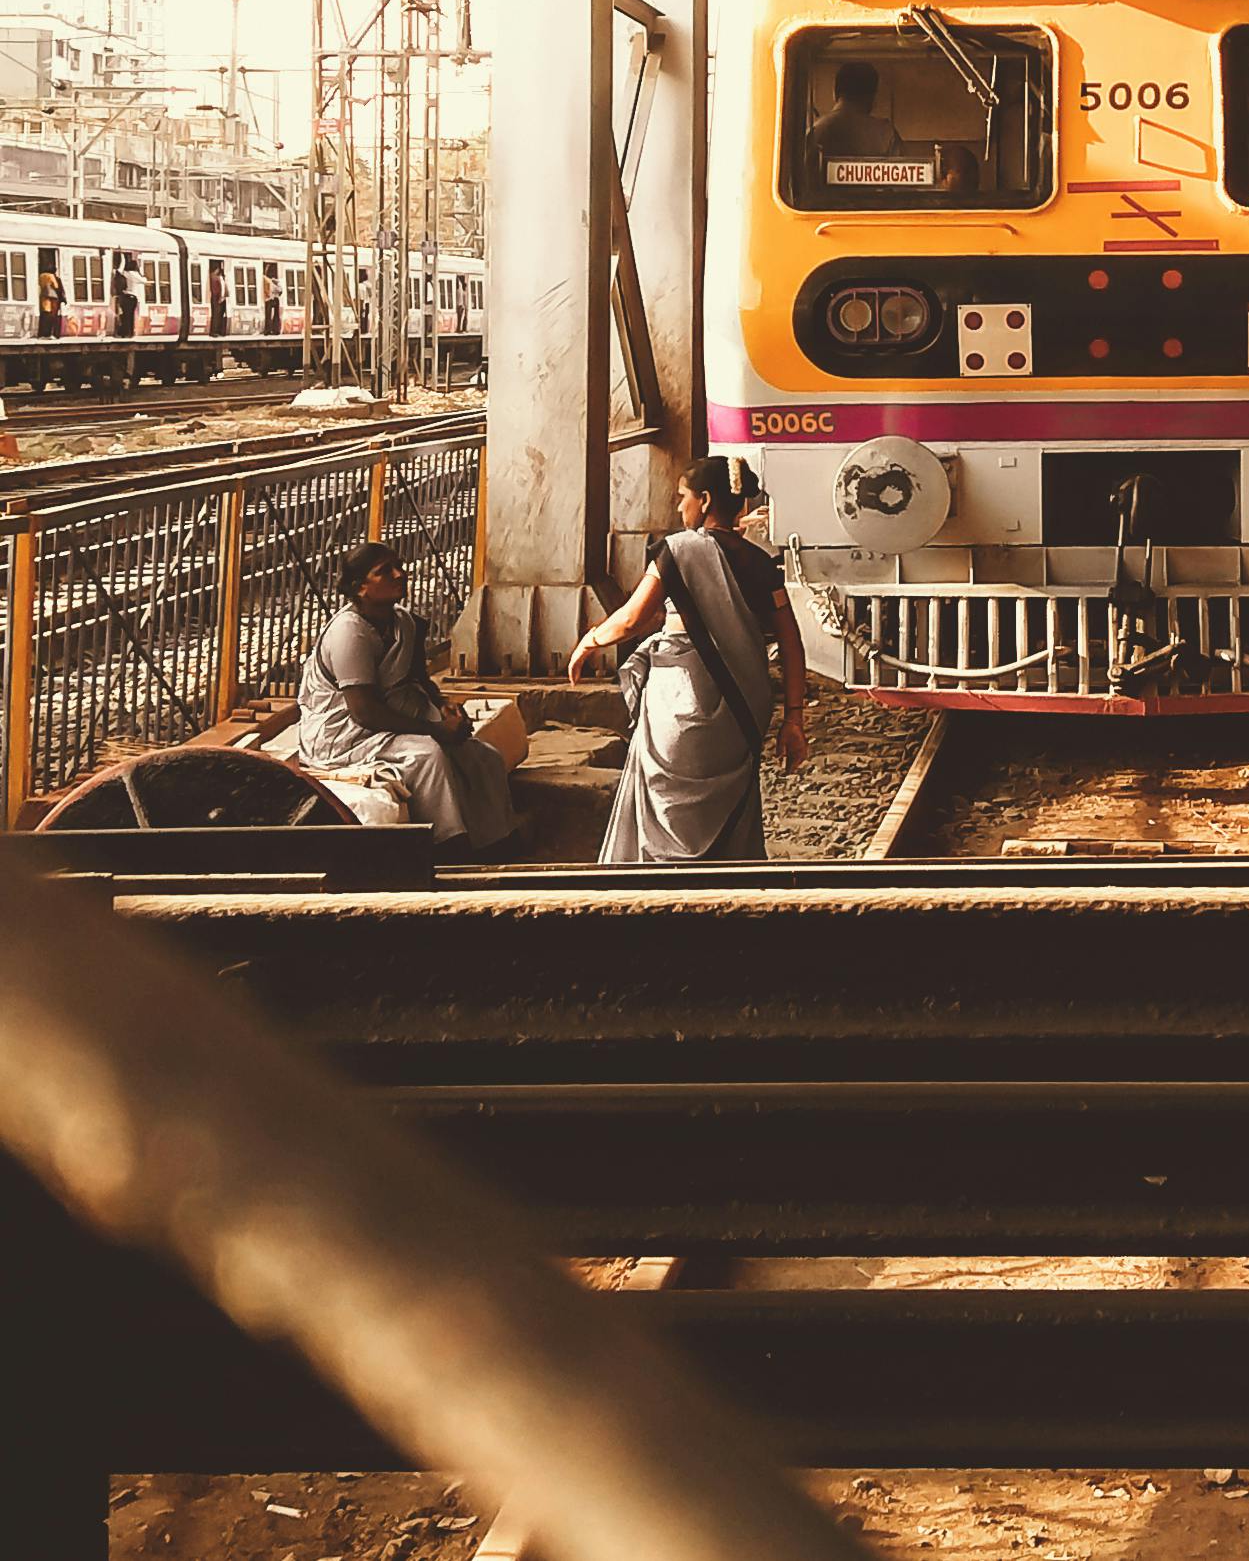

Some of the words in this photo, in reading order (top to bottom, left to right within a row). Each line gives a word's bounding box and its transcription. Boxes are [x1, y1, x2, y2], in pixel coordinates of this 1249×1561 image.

[1079, 81, 1190, 111] 5006
[836, 164, 925, 182] CHURCHGATE
[751, 412, 834, 436] 5006C
